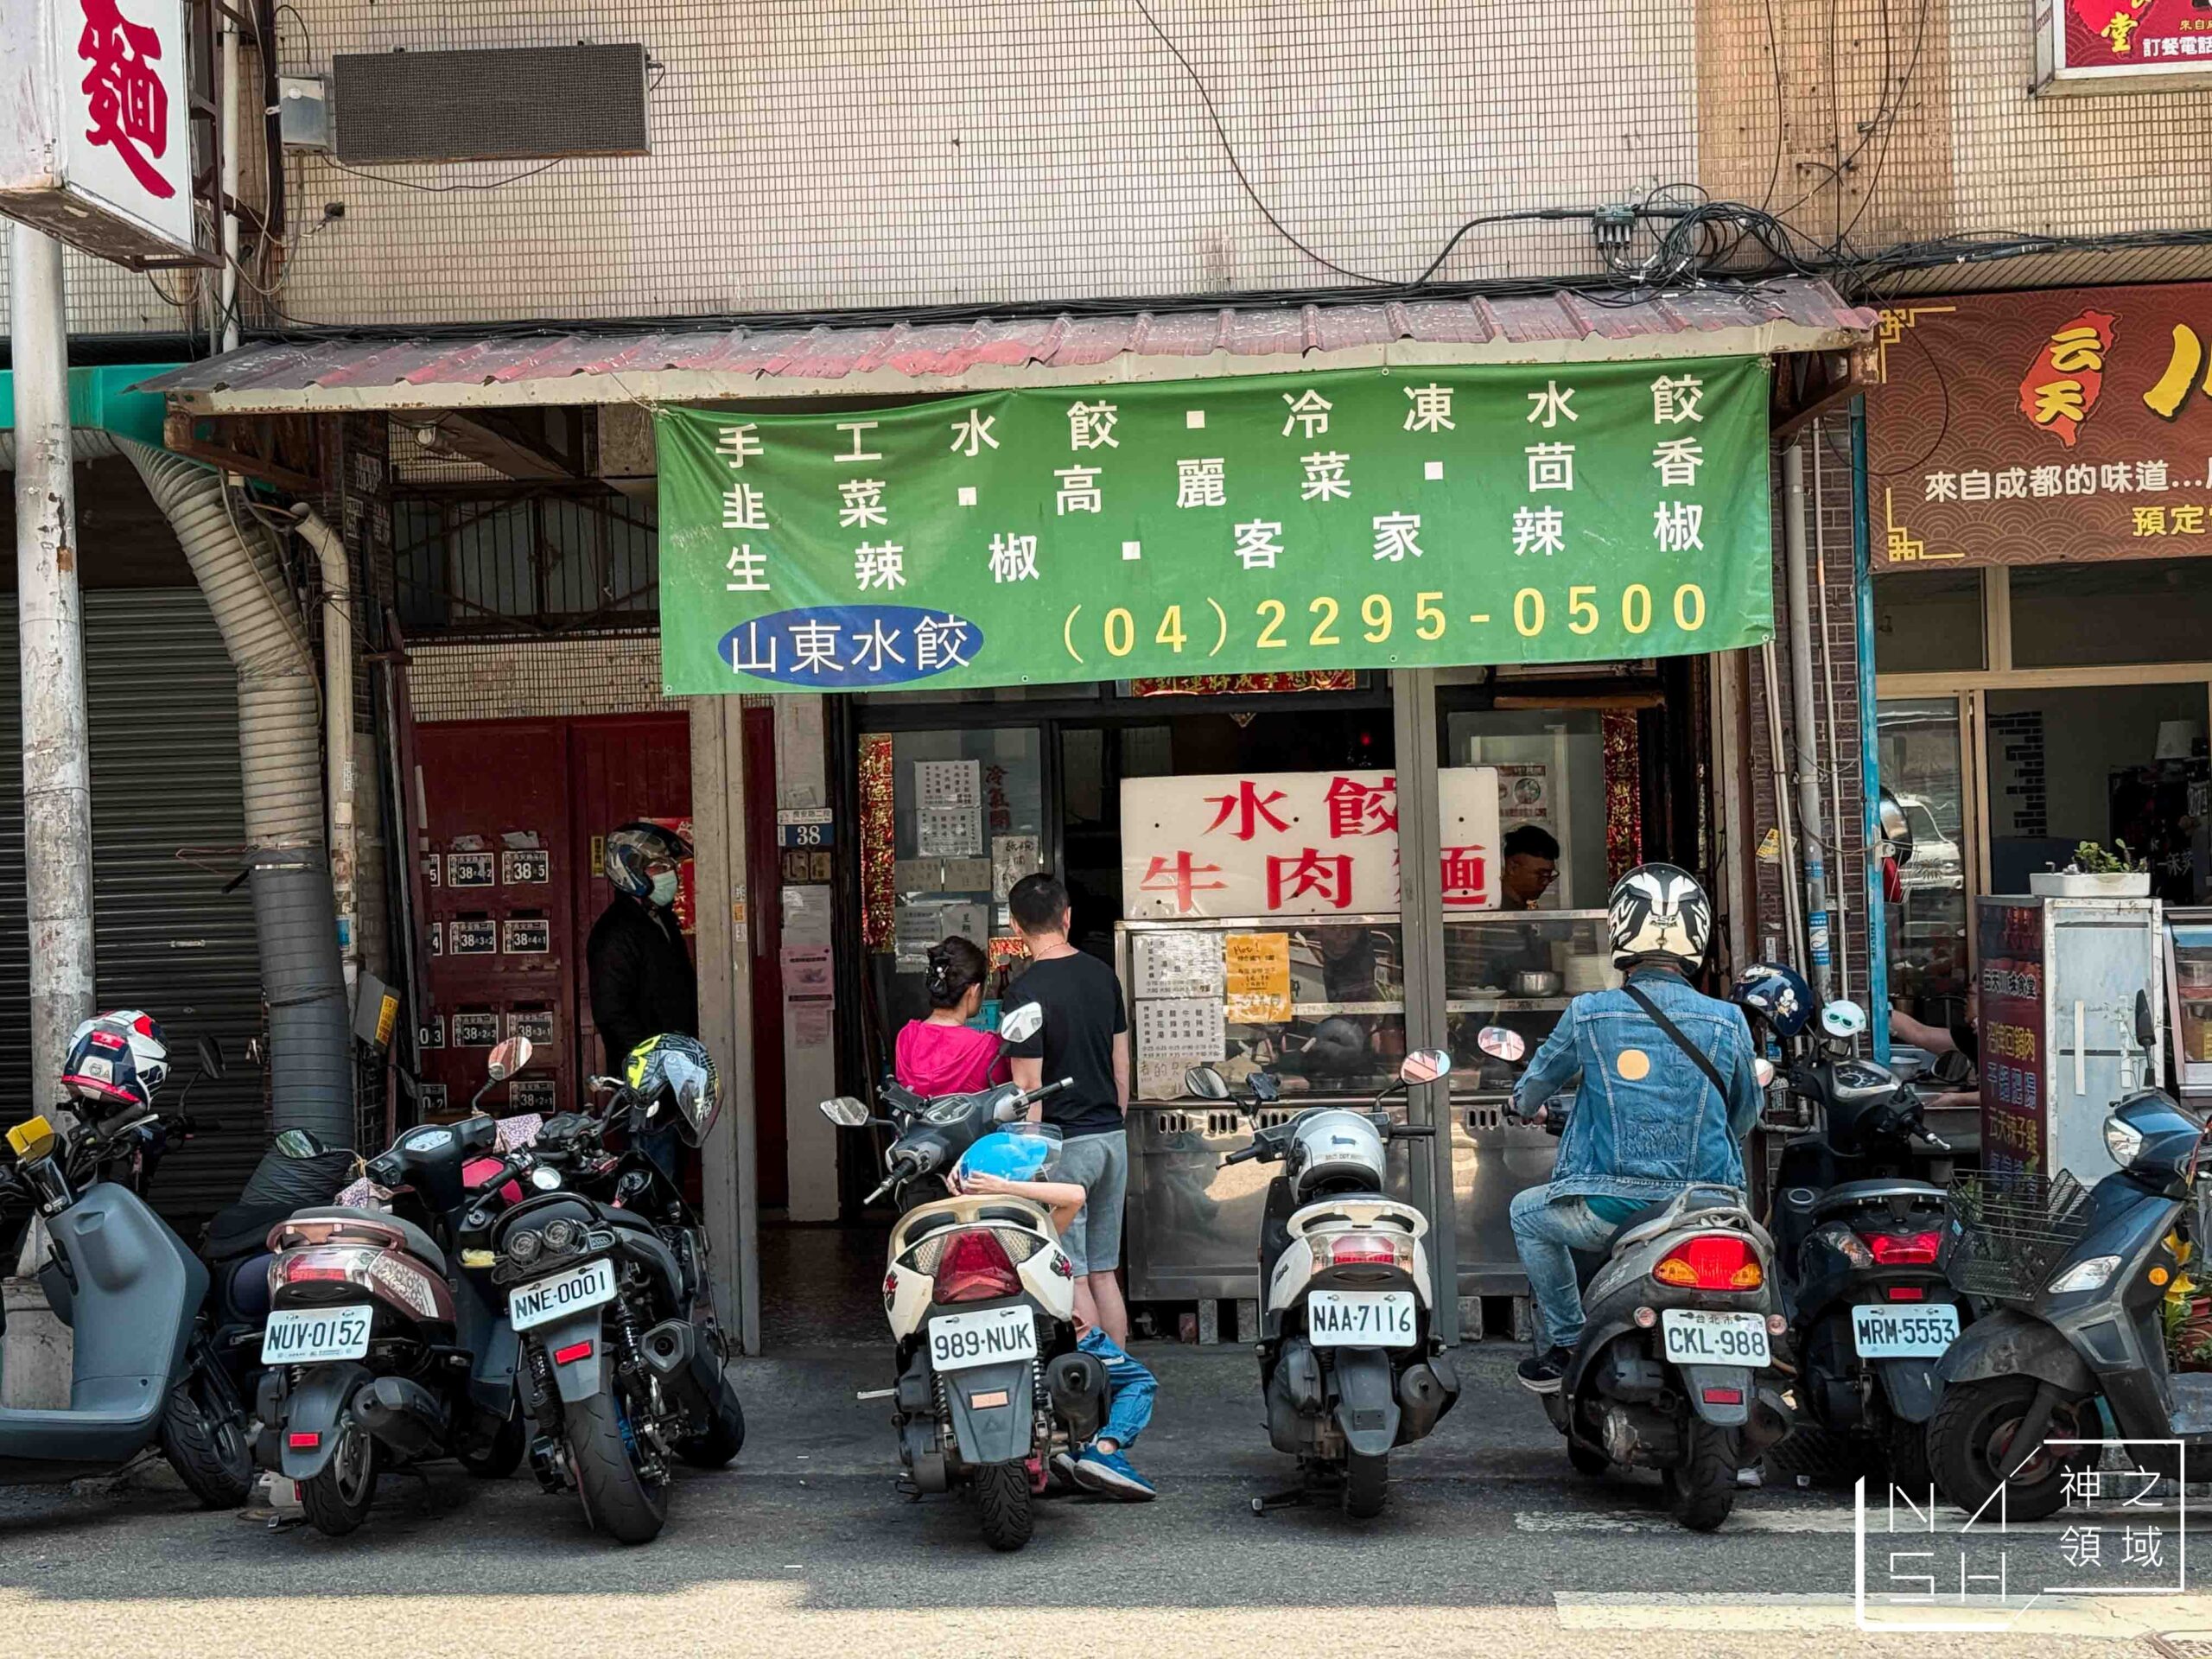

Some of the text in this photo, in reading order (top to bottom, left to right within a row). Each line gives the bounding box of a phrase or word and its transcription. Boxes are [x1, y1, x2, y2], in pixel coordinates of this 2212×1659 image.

[2142, 35, 2212, 58] 訂餐電話
[2034, 326, 2102, 424] 云天
[715, 374, 1705, 469] 手工水餃 冷凍水餃
[722, 436, 1705, 530] 韭菜 高麗菜 茴香
[2132, 503, 2212, 537] 預定
[726, 501, 1706, 592] 生辣椒 客家辣椒
[731, 614, 971, 675] 山東水餃
[1202, 777, 1398, 842] 水餃
[797, 825, 821, 845] 38
[515, 1271, 606, 1319] NNE-0001
[267, 1320, 365, 1351] NUV-0152
[1313, 1305, 1411, 1334] NAA-7116
[1858, 1318, 1956, 1346] MRM-5553
[934, 1322, 1032, 1362] 989-NUK
[1668, 1326, 1766, 1357] CKL-988
